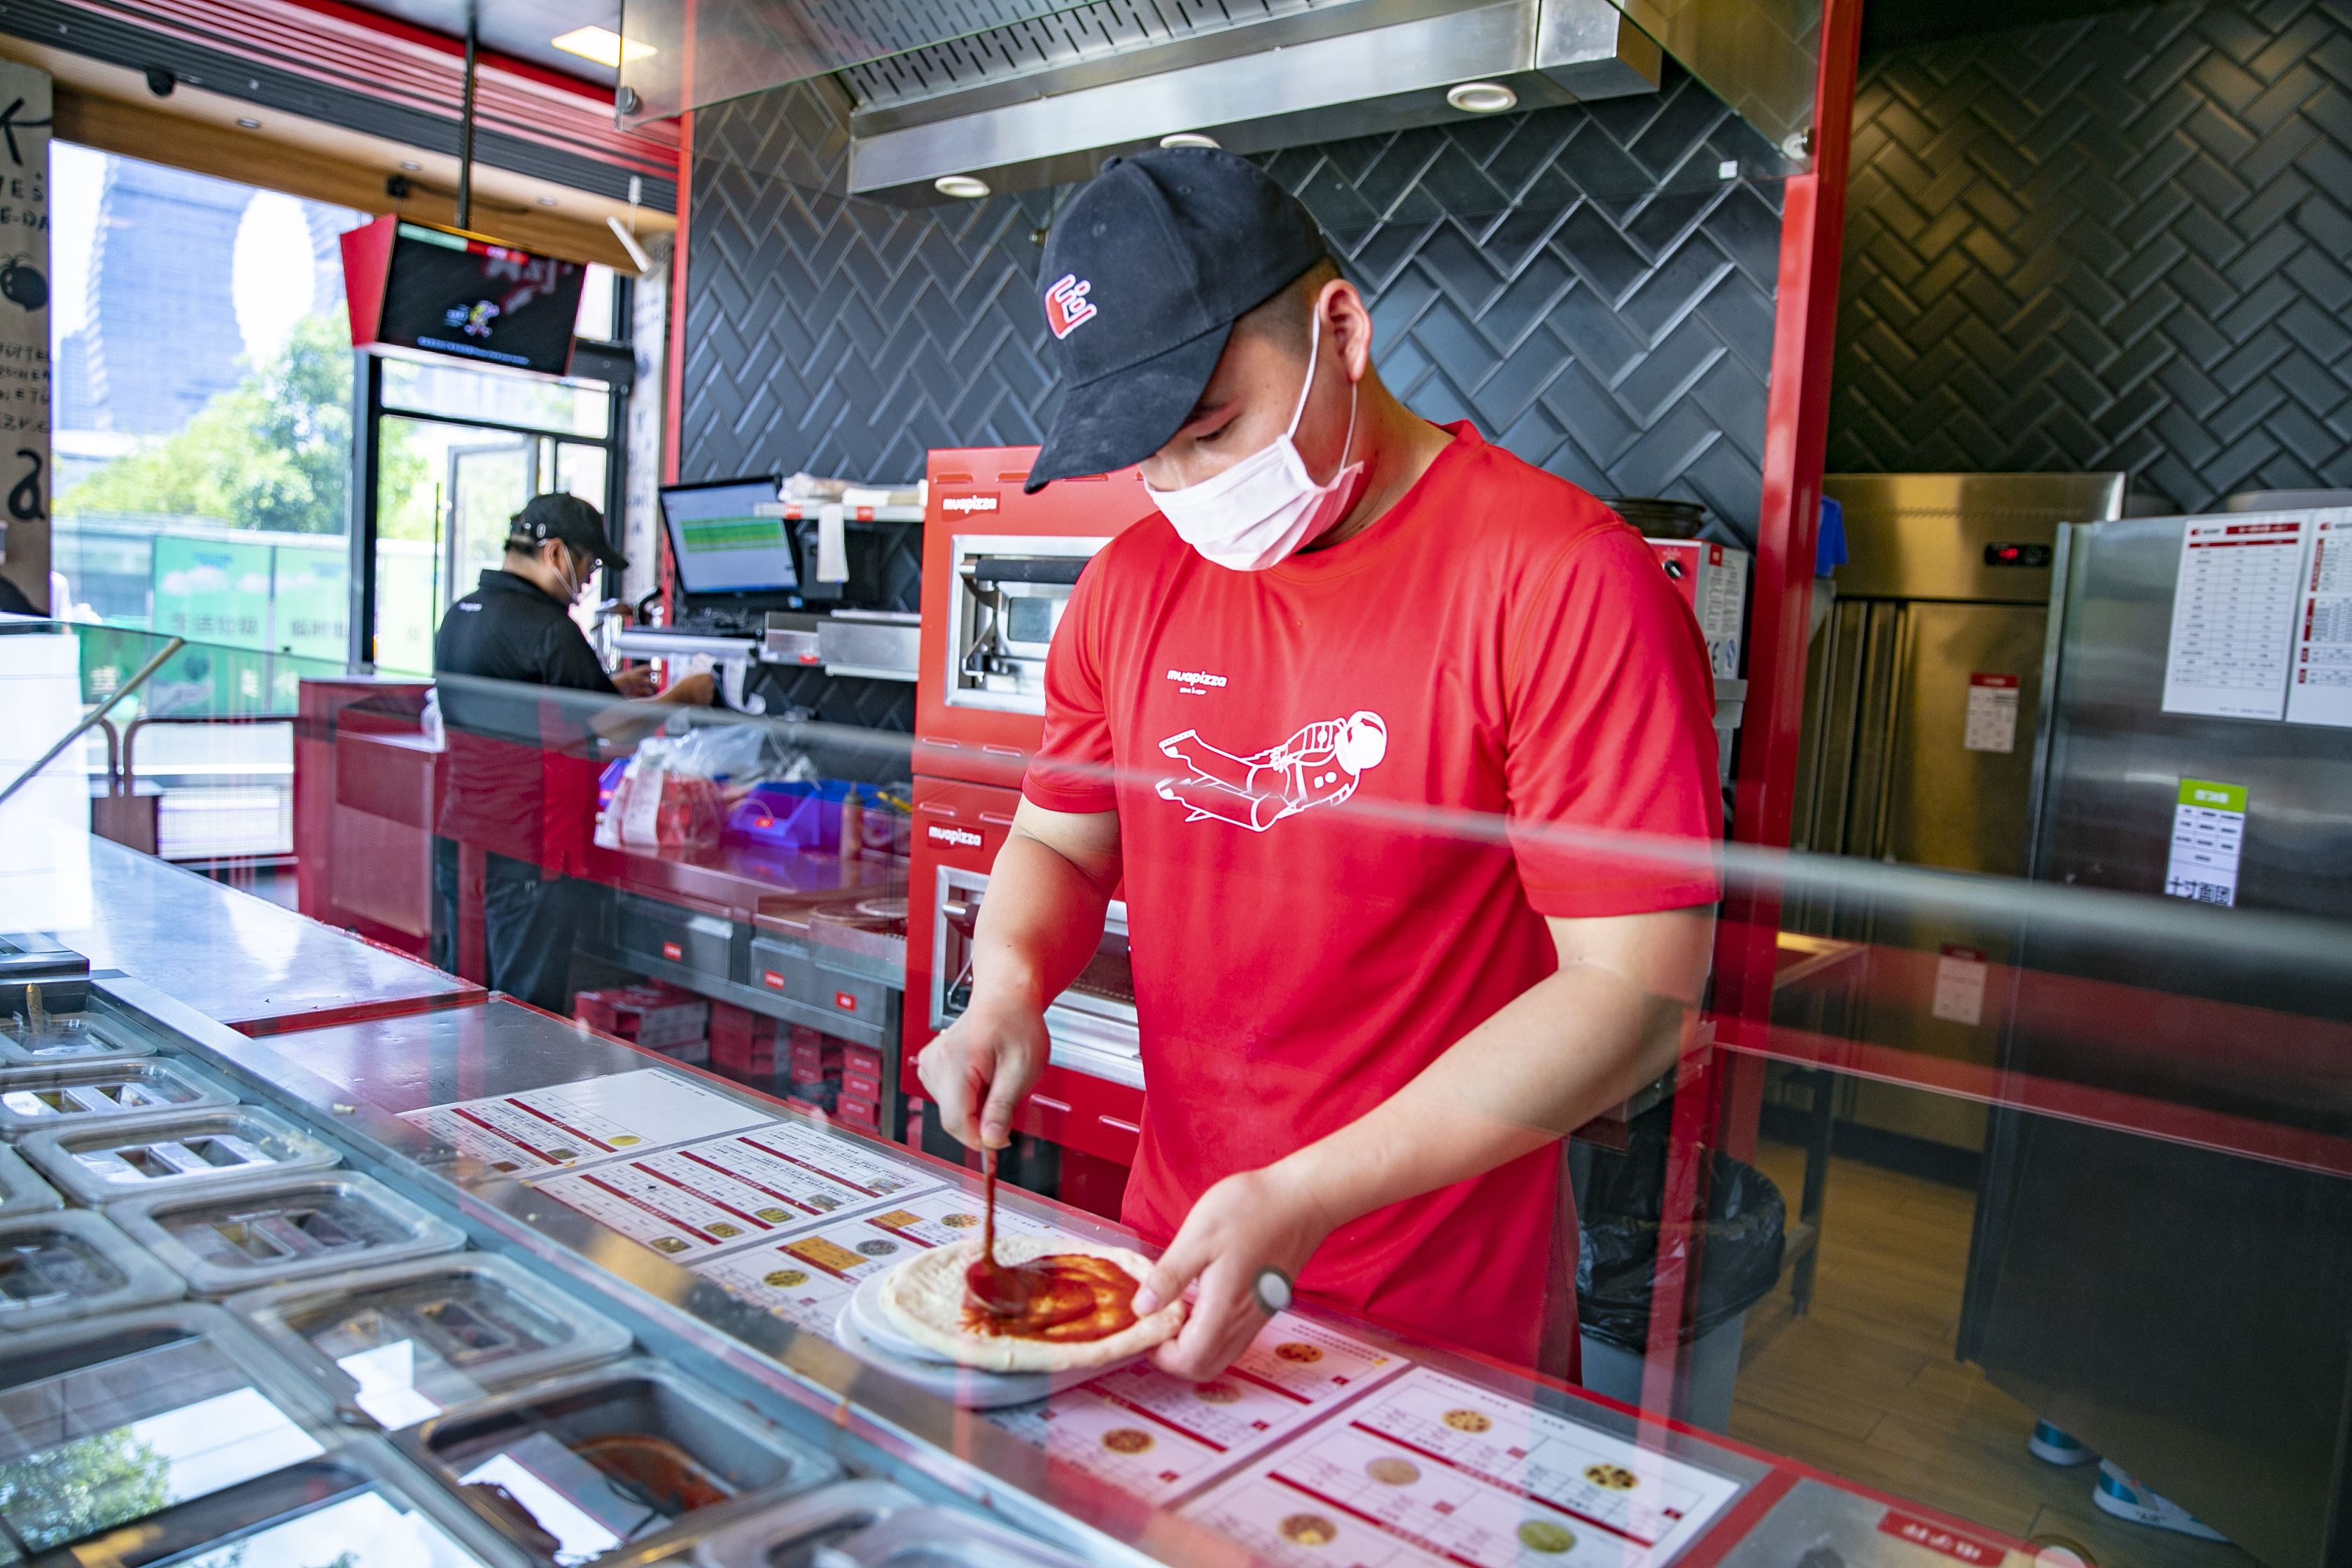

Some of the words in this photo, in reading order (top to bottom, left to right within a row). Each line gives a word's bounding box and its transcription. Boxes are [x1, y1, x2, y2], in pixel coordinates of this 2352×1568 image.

[943, 494, 997, 514] muapizza
[1167, 669, 1227, 687] muapizza
[928, 826, 981, 846] muapizza
